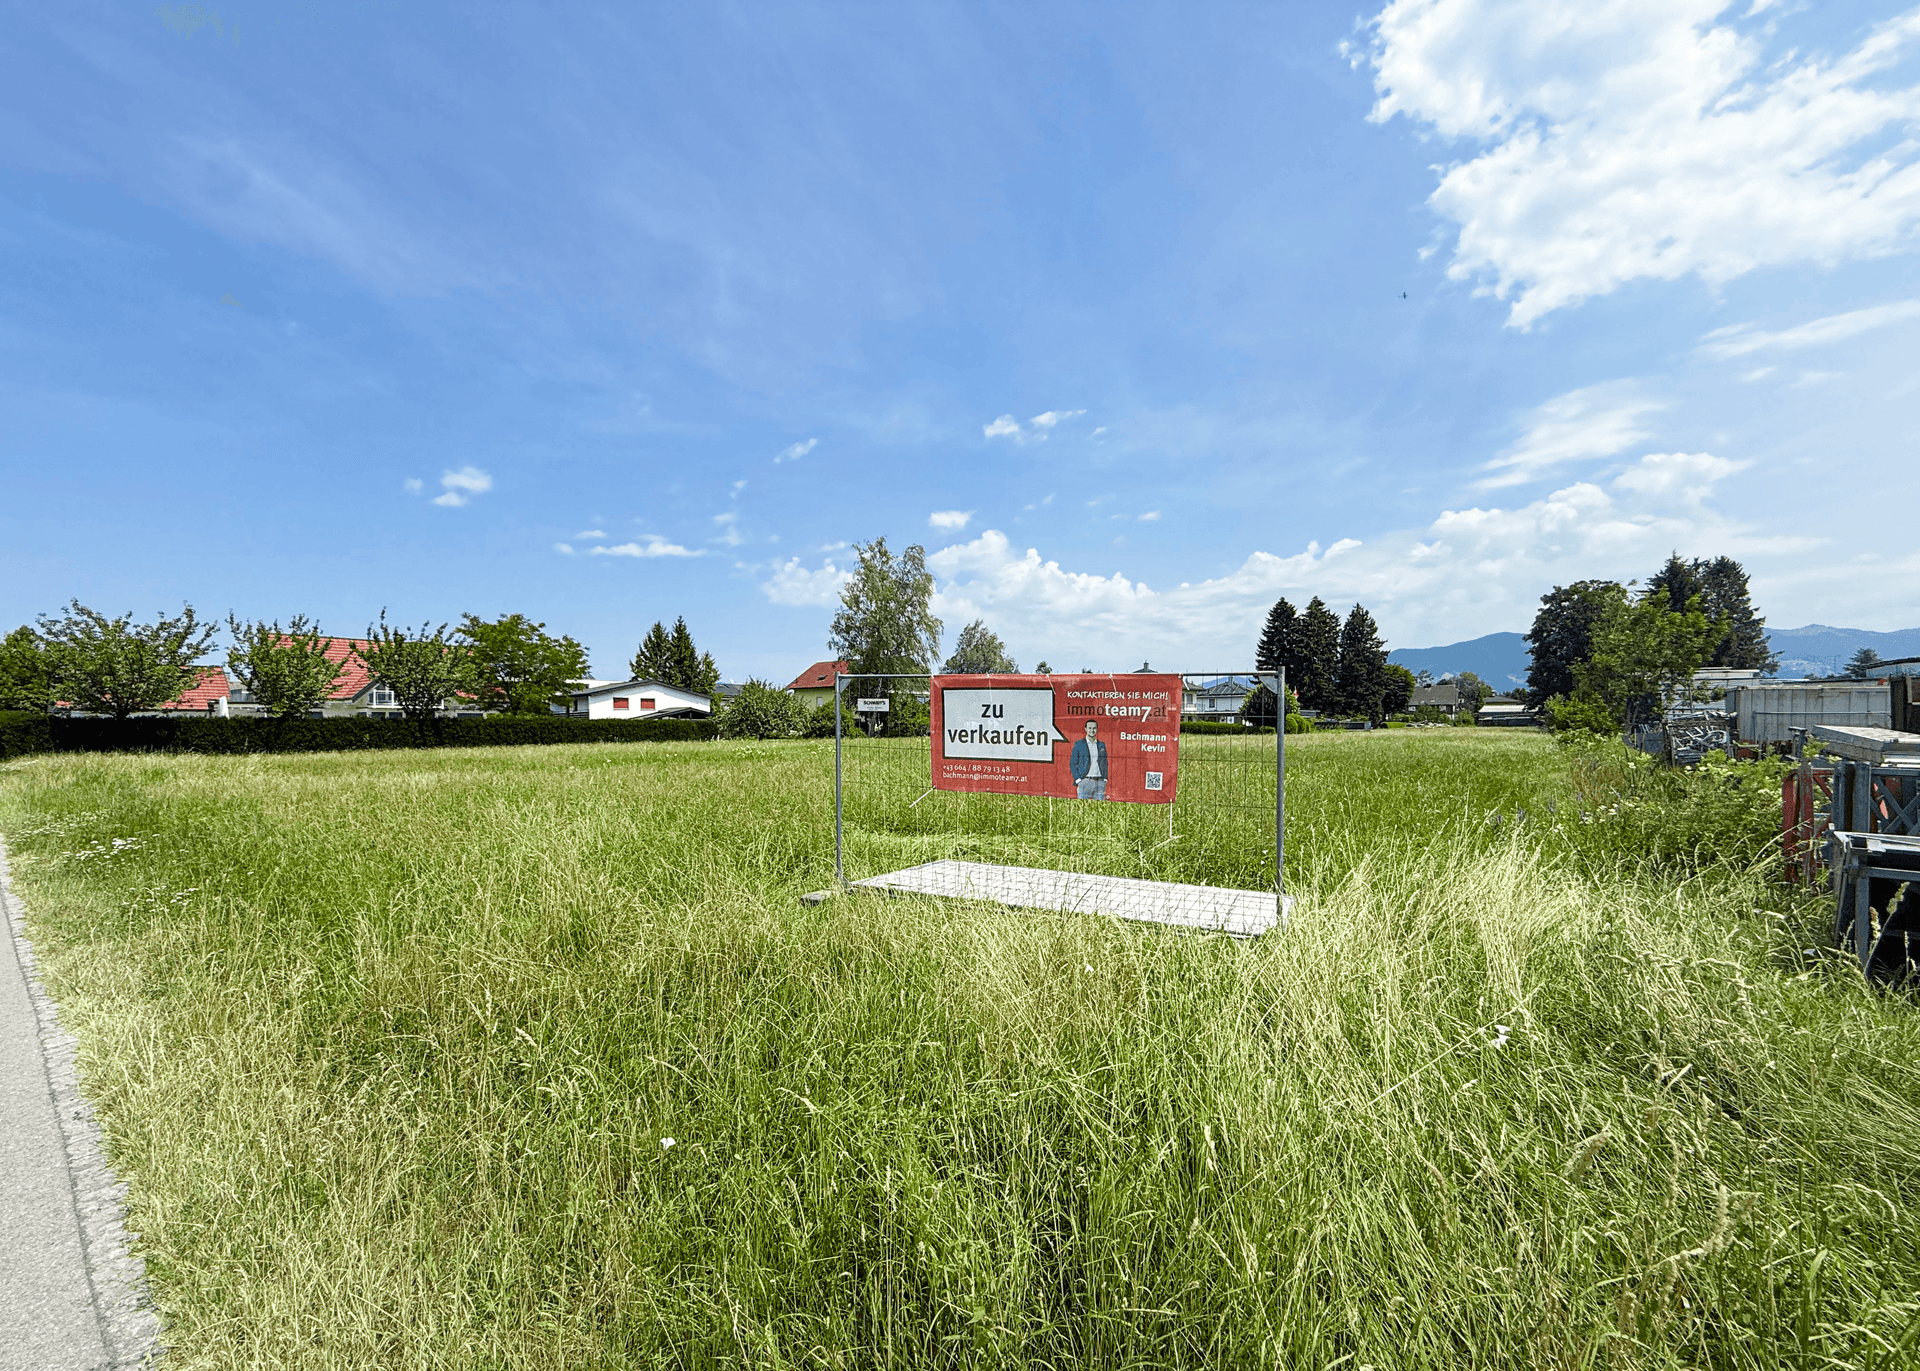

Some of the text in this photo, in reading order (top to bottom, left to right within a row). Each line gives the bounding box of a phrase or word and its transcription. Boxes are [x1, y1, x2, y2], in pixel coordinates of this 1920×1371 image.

[1067, 691, 1125, 699] KONTAKTIEREN
[1143, 691, 1168, 700] MICH!
[981, 703, 1004, 719] zu
[1067, 702, 1166, 722] immoteam7.at
[947, 725, 1049, 746] verkaufen
[1120, 731, 1166, 742] Bachmann
[1141, 743, 1166, 753] Kevin
[954, 763, 966, 772] 664
[983, 765, 992, 773] 79
[1001, 765, 1011, 773] 48
[942, 771, 1028, 782] bachmann@immoteam7.at
